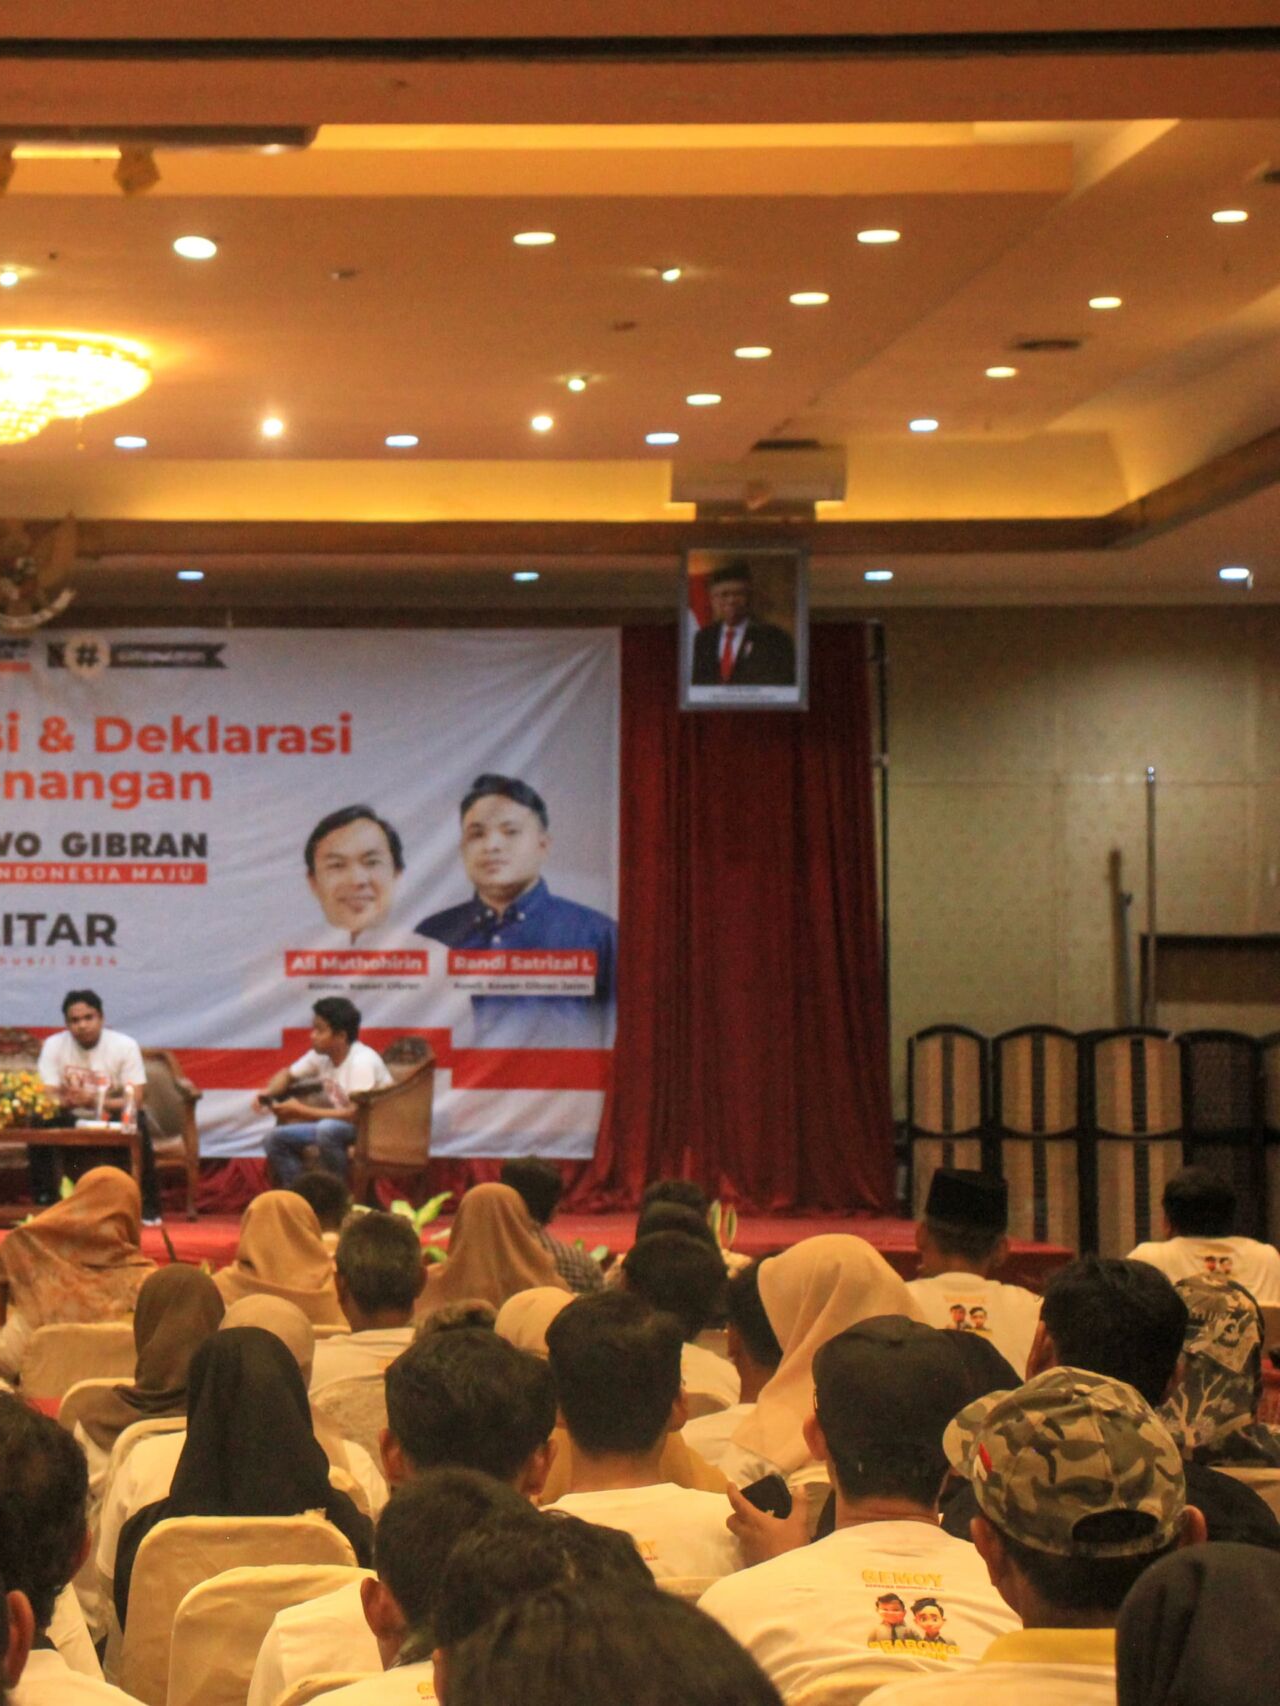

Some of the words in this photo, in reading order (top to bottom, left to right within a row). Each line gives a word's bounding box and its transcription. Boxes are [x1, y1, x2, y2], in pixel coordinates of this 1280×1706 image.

[39, 716, 75, 753] &
[95, 712, 352, 754] Deklarasi
[61, 833, 207, 858] GIBRAN
[131, 865, 194, 881] MAJU
[291, 955, 316, 970] Ali
[454, 954, 505, 970] Randi
[861, 1569, 944, 1587] GEMOY
